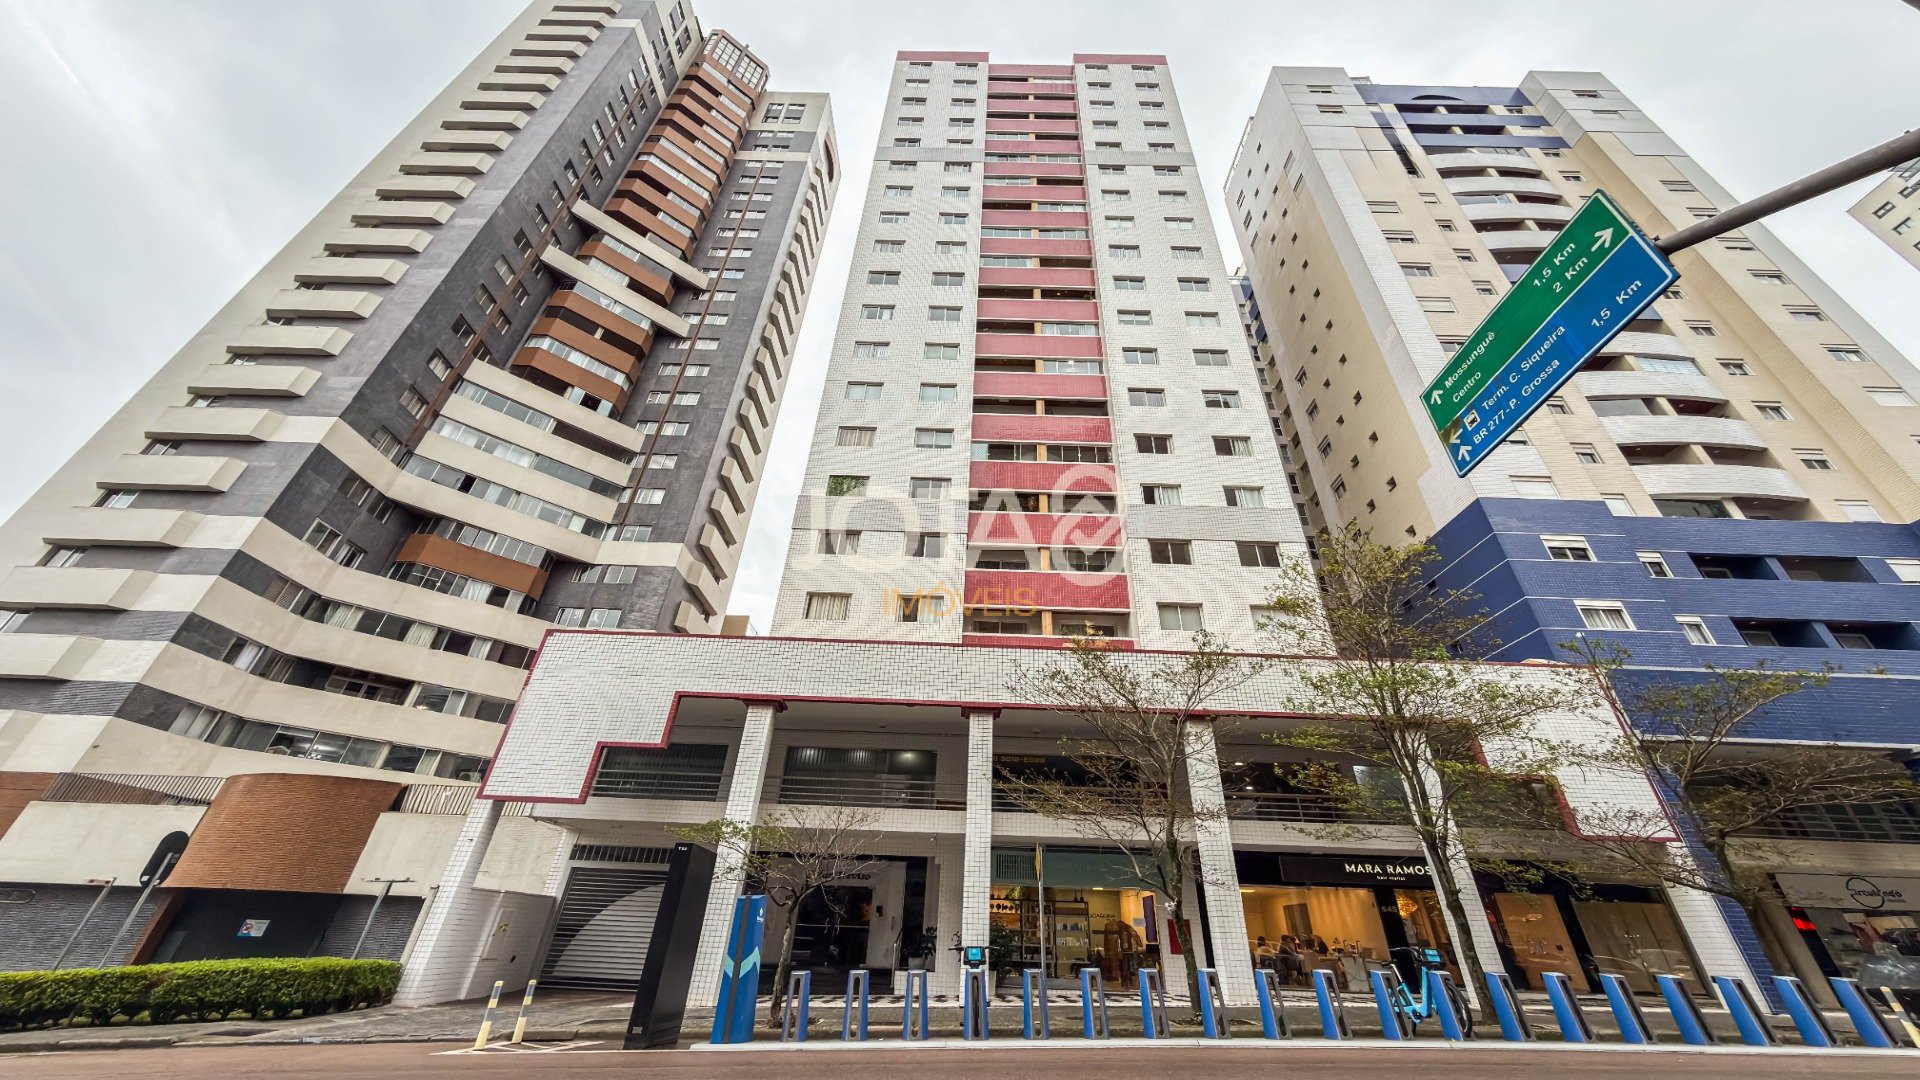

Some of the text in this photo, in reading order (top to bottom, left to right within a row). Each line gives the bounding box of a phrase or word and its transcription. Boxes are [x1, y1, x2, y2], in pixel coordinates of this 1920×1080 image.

[1444, 243, 1576, 388] Mossunguê 1,5 Km
[1452, 257, 1588, 403] Centro 2 Km
[1473, 428, 1489, 444] BR
[1521, 359, 1560, 397] Grossa
[1591, 307, 1611, 327] 1,5
[1615, 280, 1642, 305] Km
[1481, 326, 1566, 410] Term. C. Siqueira
[1344, 862, 1432, 876] MARA RAMOS
